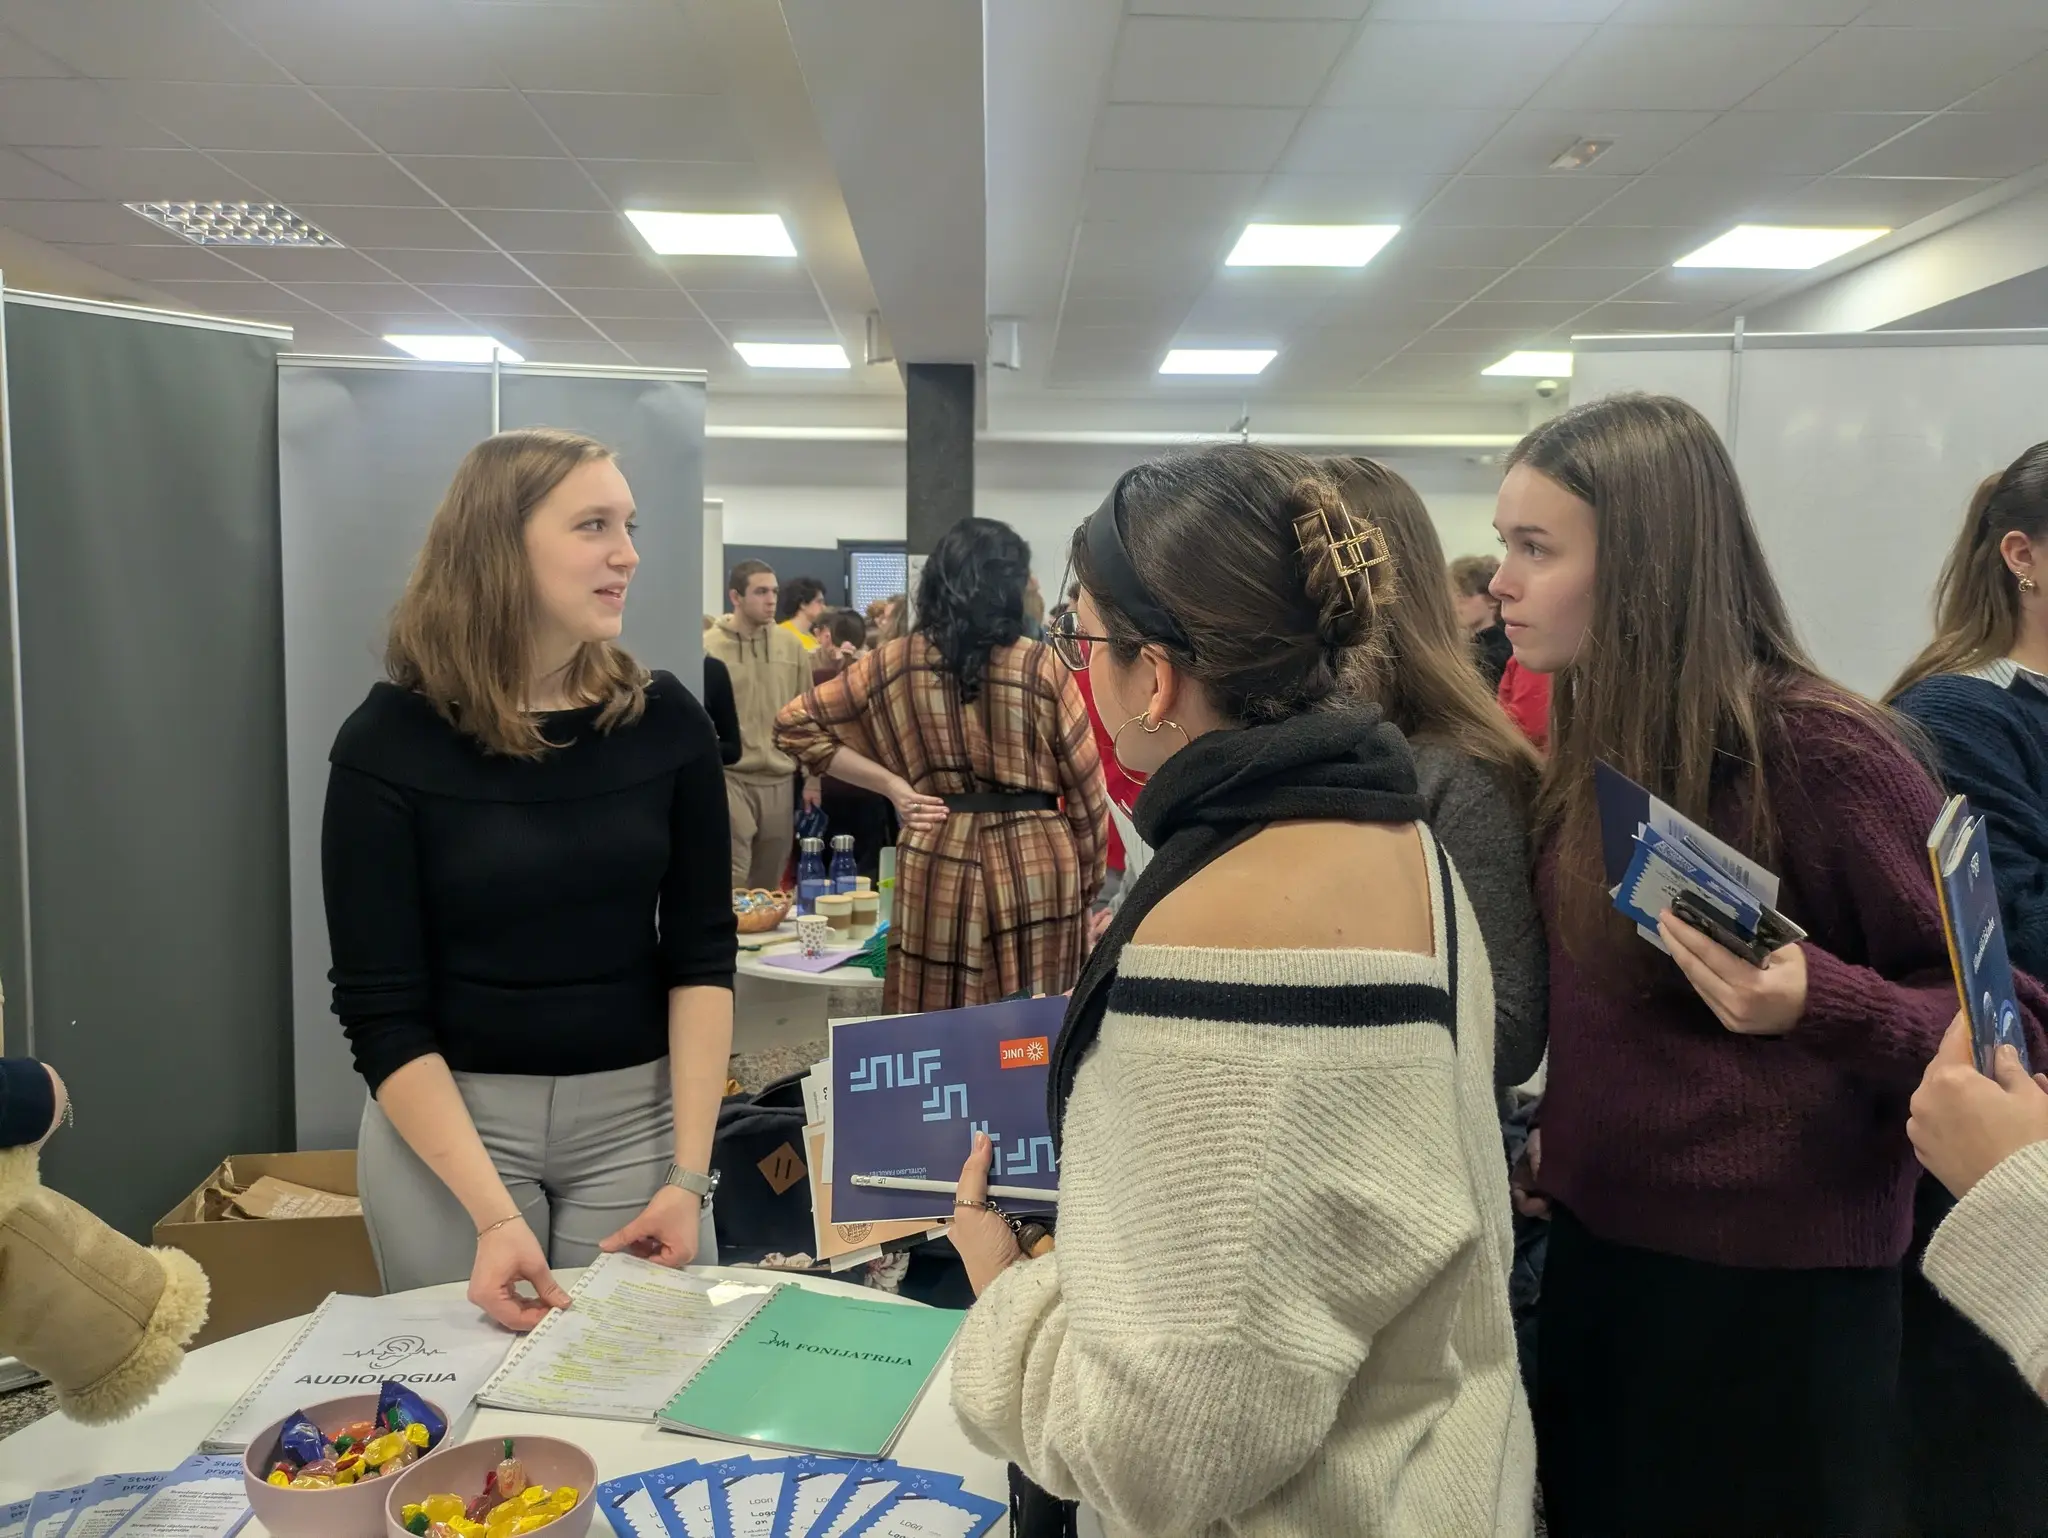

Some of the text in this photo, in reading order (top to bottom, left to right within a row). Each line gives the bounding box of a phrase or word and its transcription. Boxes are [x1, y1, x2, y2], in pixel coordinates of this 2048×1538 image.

[1002, 1048, 1024, 1060] UNIC
[796, 1343, 913, 1366] FONIJATRIJA
[295, 1372, 457, 1385] AUDIOLOGIJA
